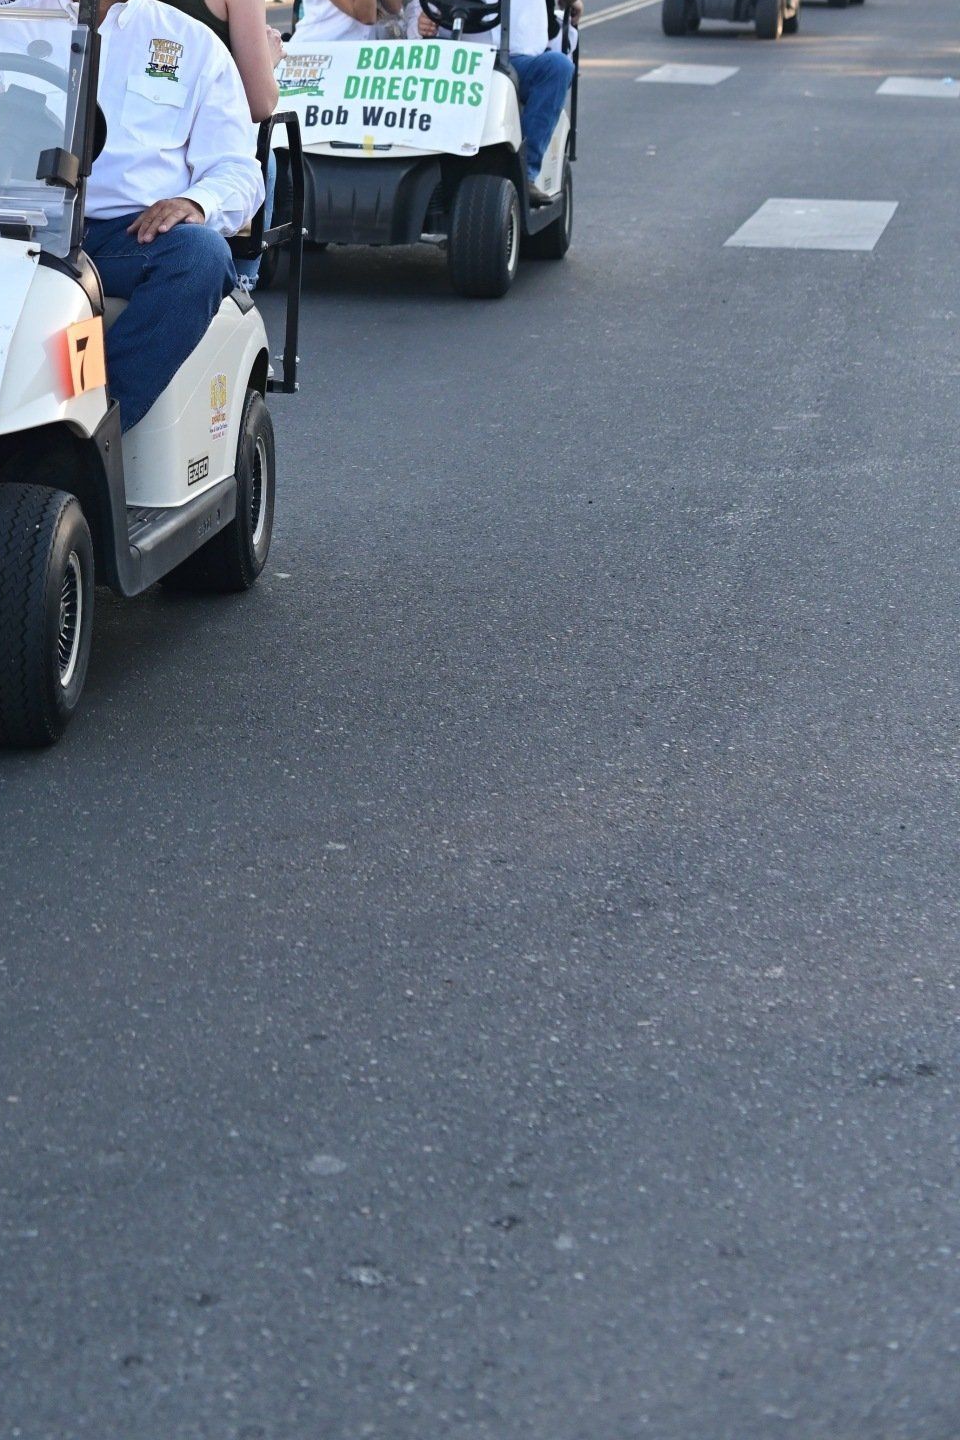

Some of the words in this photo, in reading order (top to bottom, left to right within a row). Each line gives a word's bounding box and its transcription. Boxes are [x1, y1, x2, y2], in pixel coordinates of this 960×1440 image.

[356, 44, 440, 71] BOARD
[451, 48, 483, 75] OF
[343, 75, 484, 107] DIRECTORS
[305, 105, 348, 127] Bob
[362, 106, 432, 131] Wolfe
[76, 335, 89, 391] 7
